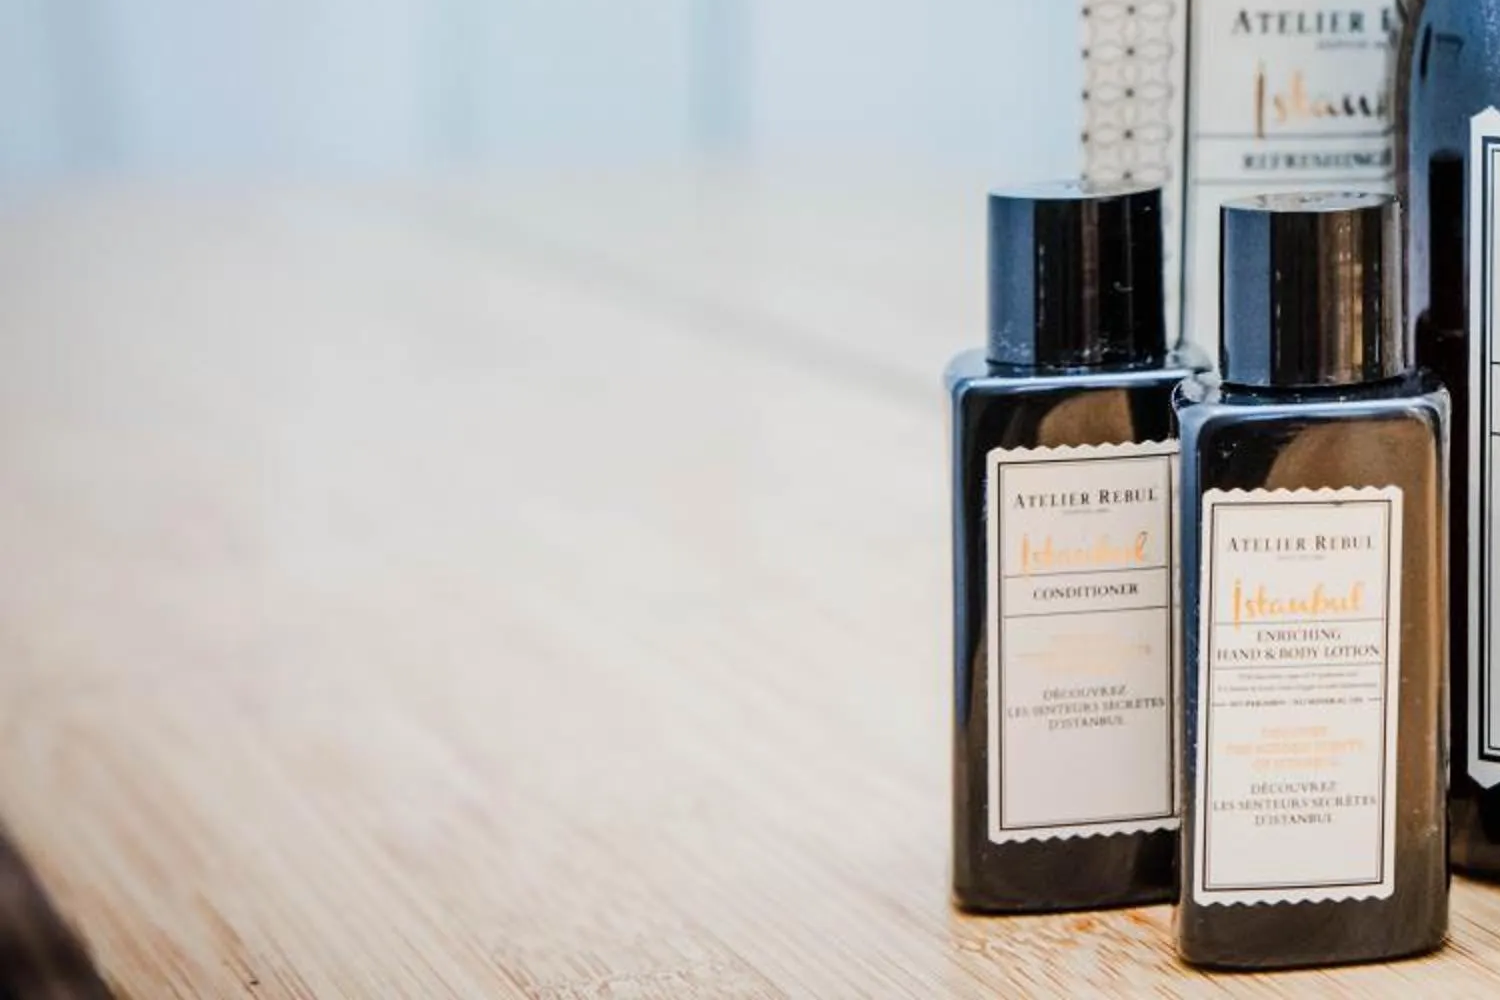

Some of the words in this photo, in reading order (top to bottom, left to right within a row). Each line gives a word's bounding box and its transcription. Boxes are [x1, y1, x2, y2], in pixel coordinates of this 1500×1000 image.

[1232, 9, 1365, 34] ATELIER
[1014, 492, 1091, 509] ATELIER
[1228, 536, 1306, 552] ATELIER
[1033, 583, 1139, 601] CONDITIONER
[1217, 647, 1261, 662] HAND
[1264, 647, 1276, 660] &
[1279, 646, 1320, 660] BODY
[1324, 644, 1380, 658] LOTION
